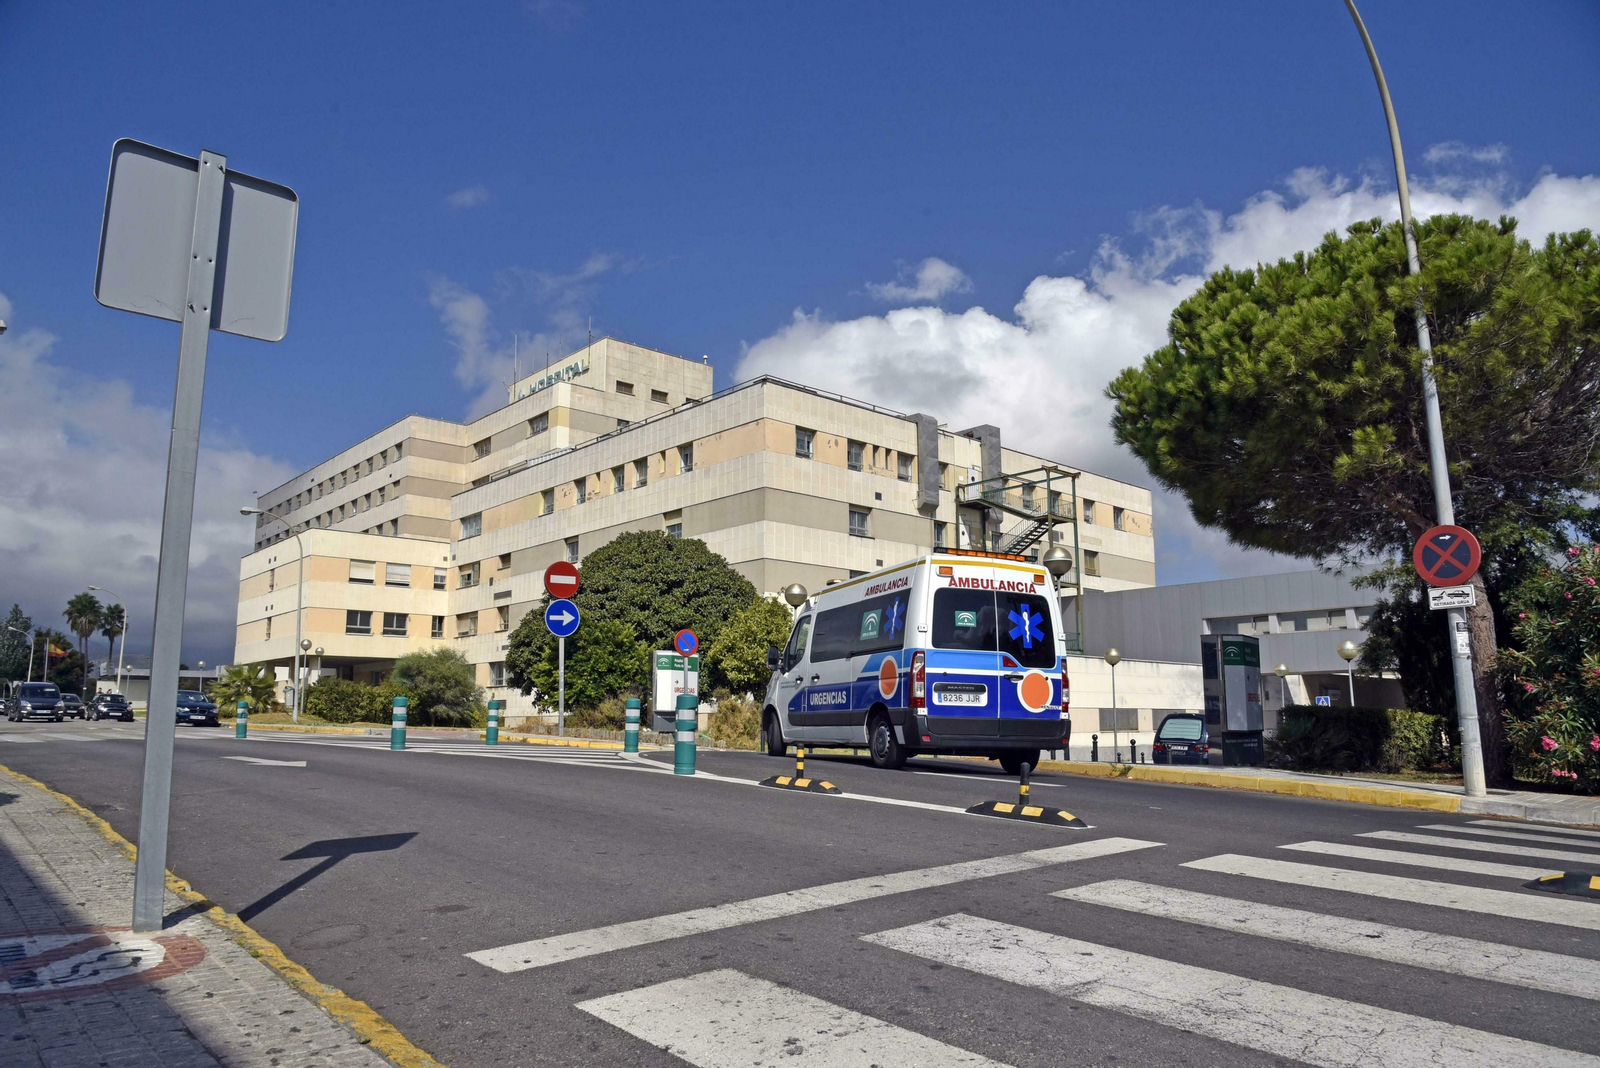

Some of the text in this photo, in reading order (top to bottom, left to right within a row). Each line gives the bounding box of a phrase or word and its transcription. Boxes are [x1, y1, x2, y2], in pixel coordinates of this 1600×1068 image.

[529, 359, 589, 394] HOSPITAL
[864, 576, 909, 597] AMBULANCIA
[948, 577, 1037, 594] AMBULANCIA
[810, 691, 847, 706] URGENCIAS
[942, 694, 980, 703] 8236 JJR
